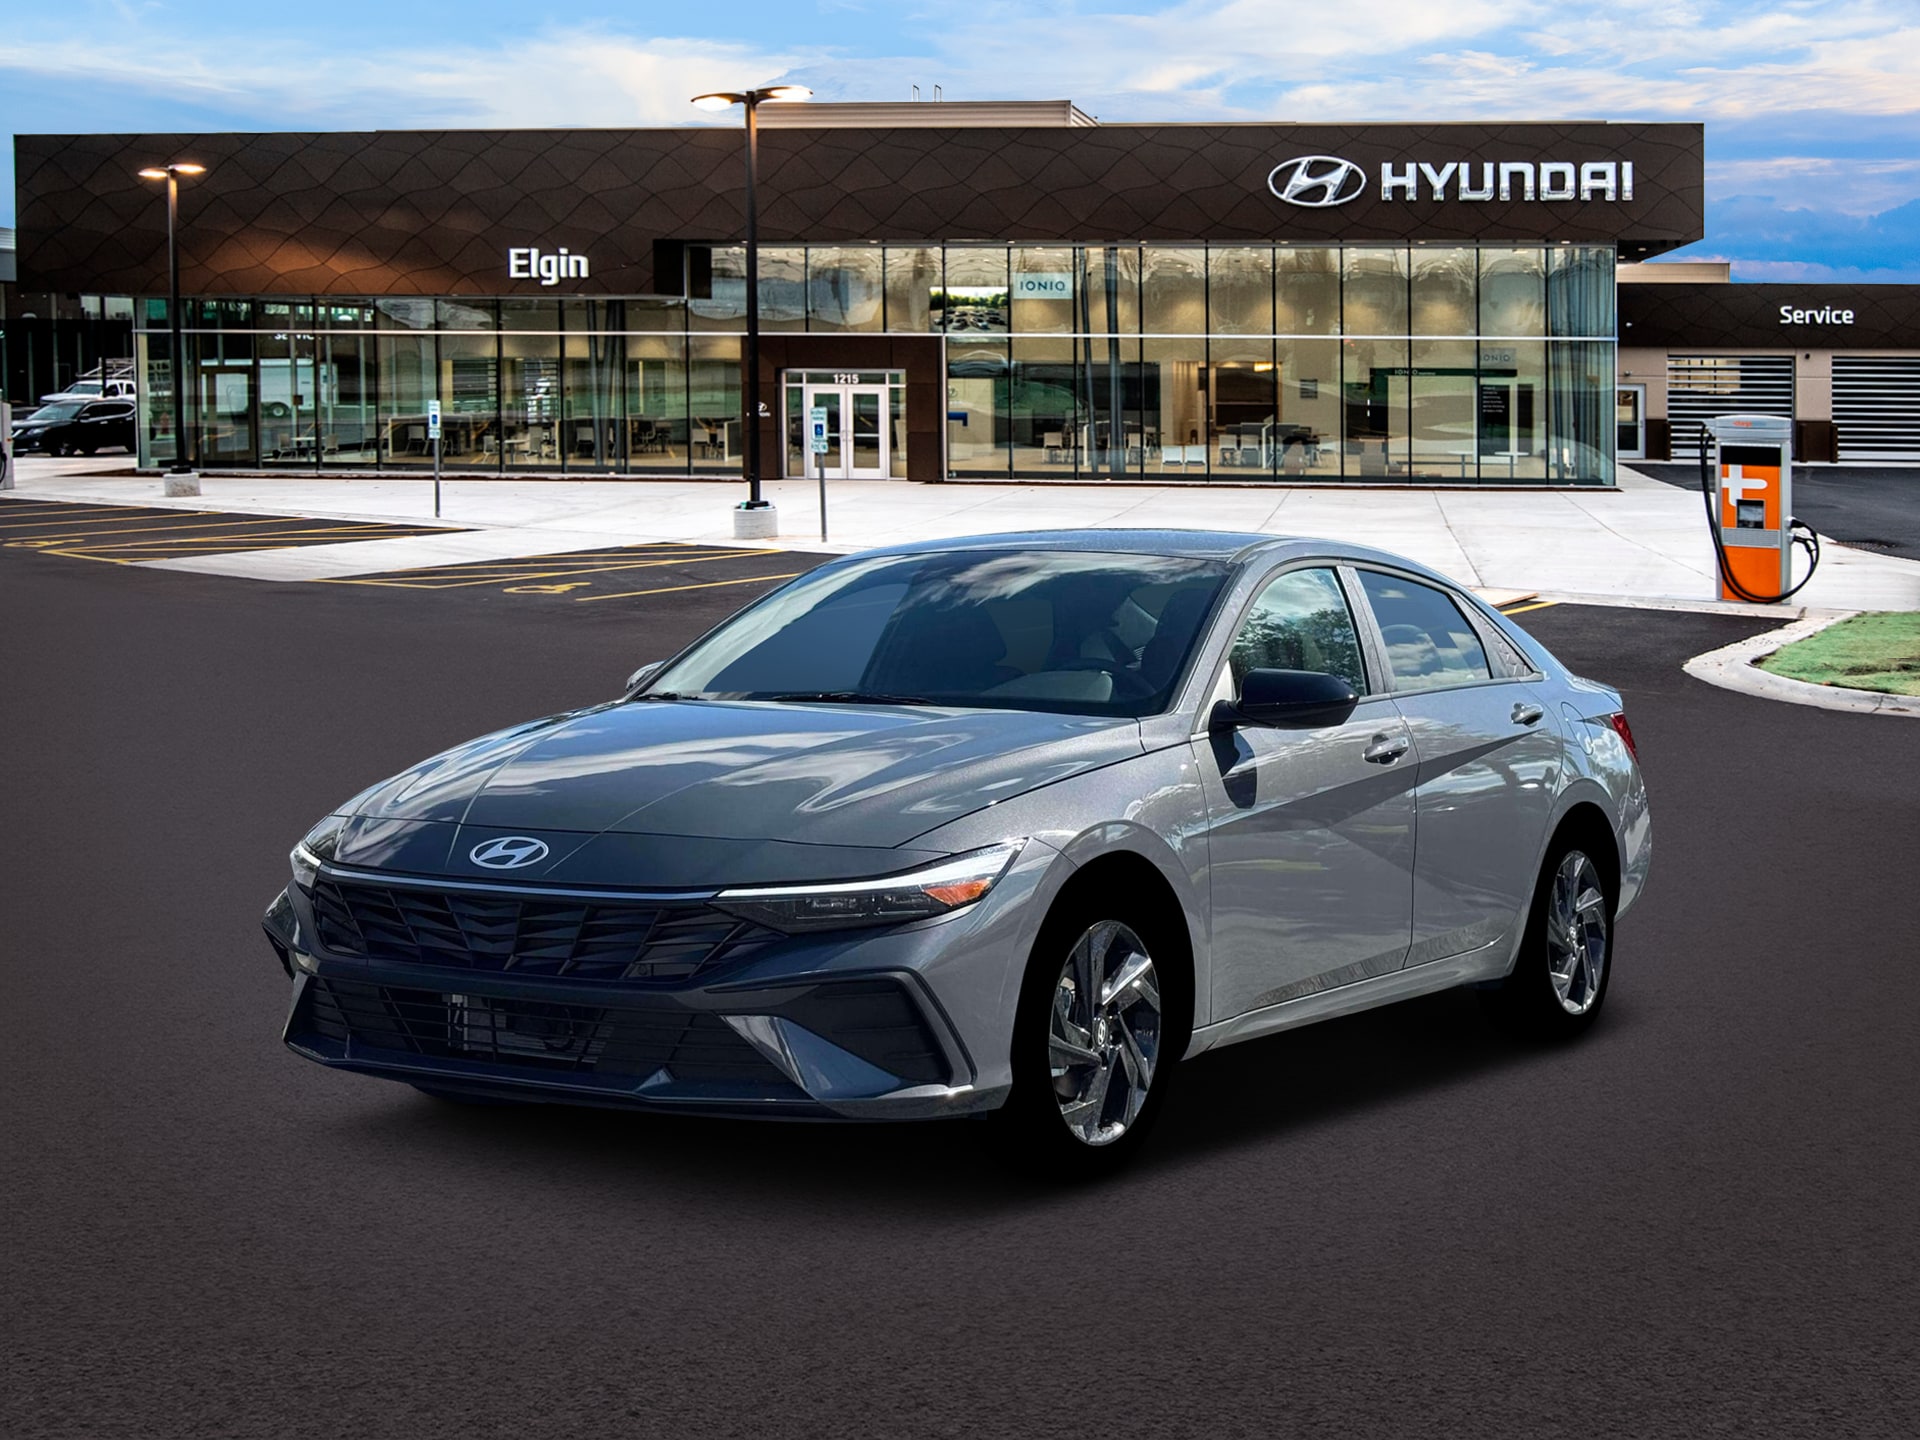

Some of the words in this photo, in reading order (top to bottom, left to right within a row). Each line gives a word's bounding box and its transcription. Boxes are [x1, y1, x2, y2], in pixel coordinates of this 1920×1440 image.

[1381, 161, 1634, 201] HYUNDAI
[508, 247, 590, 286] Elgin
[1020, 280, 1066, 291] IONIQ
[1779, 305, 1854, 324] Service
[833, 373, 860, 384] 1215
